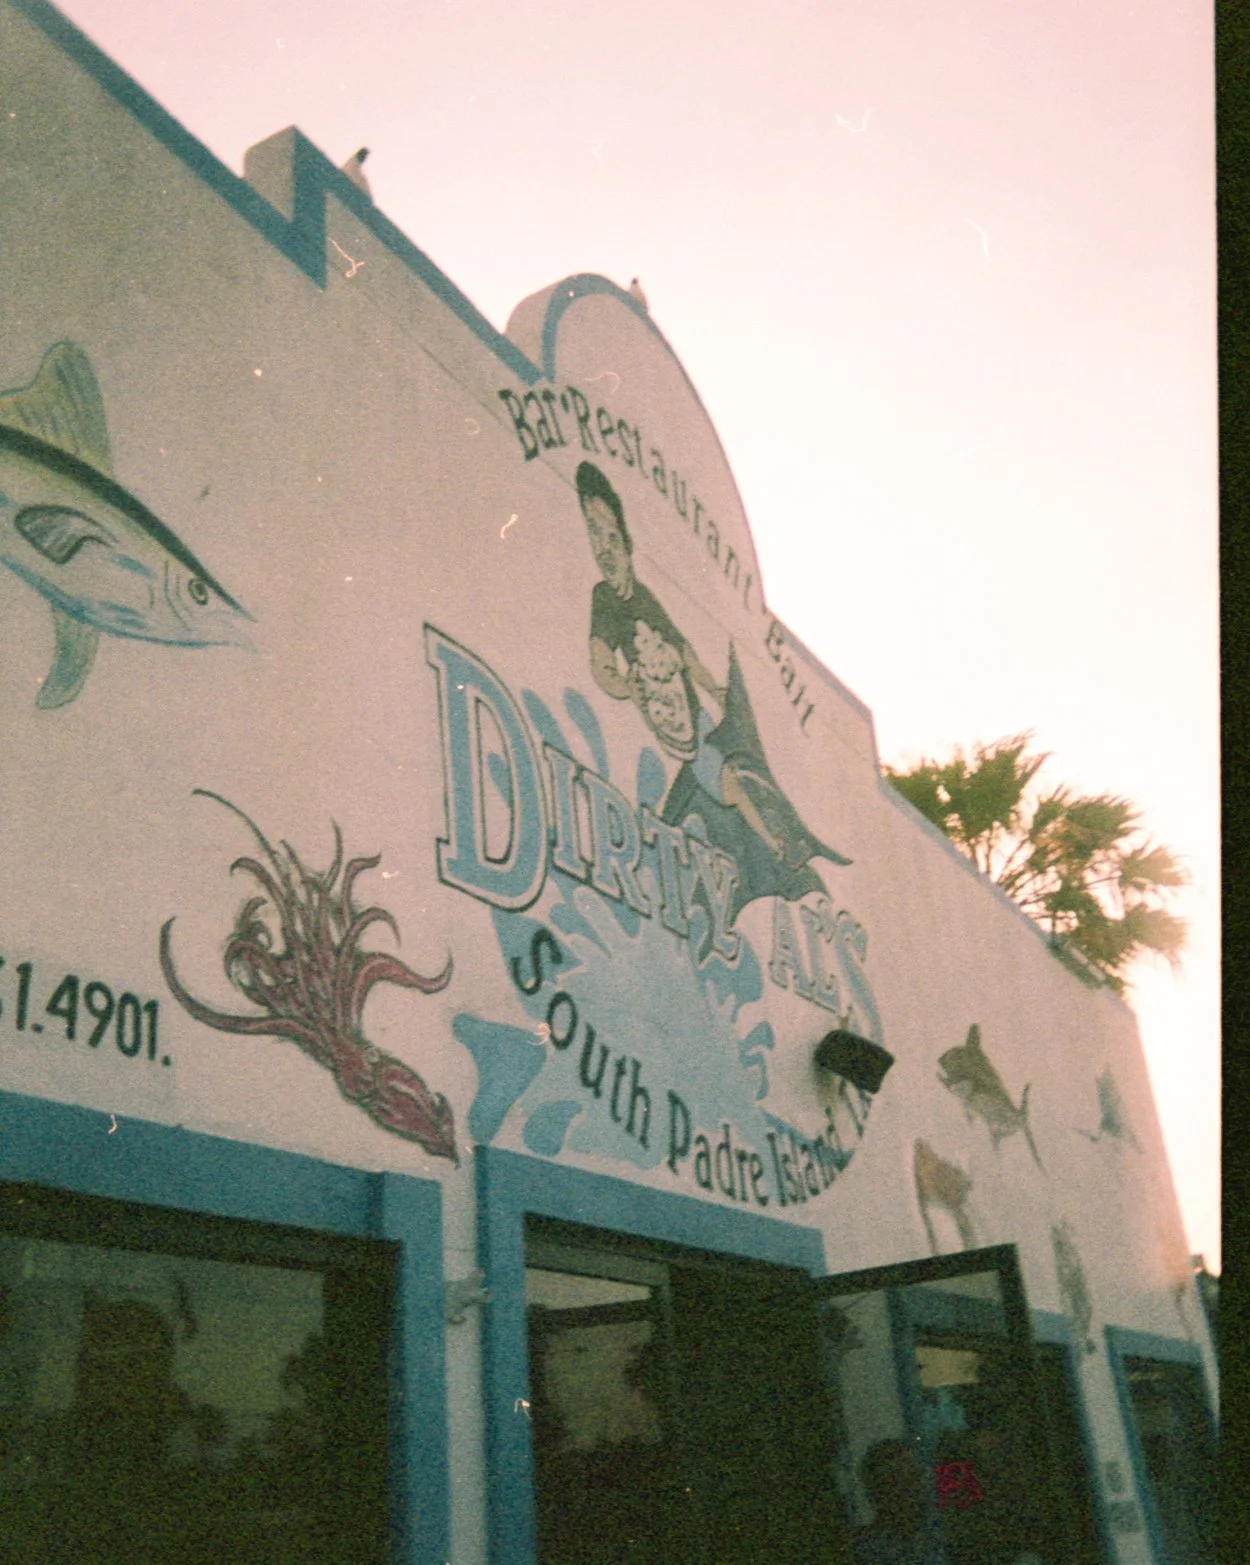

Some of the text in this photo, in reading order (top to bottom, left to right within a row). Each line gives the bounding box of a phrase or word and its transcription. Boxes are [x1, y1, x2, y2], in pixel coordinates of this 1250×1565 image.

[423, 622, 743, 964] DIRTY
[0, 955, 172, 1068] 1.4901.
[511, 929, 652, 1150] South
[666, 1089, 768, 1208] Padre
